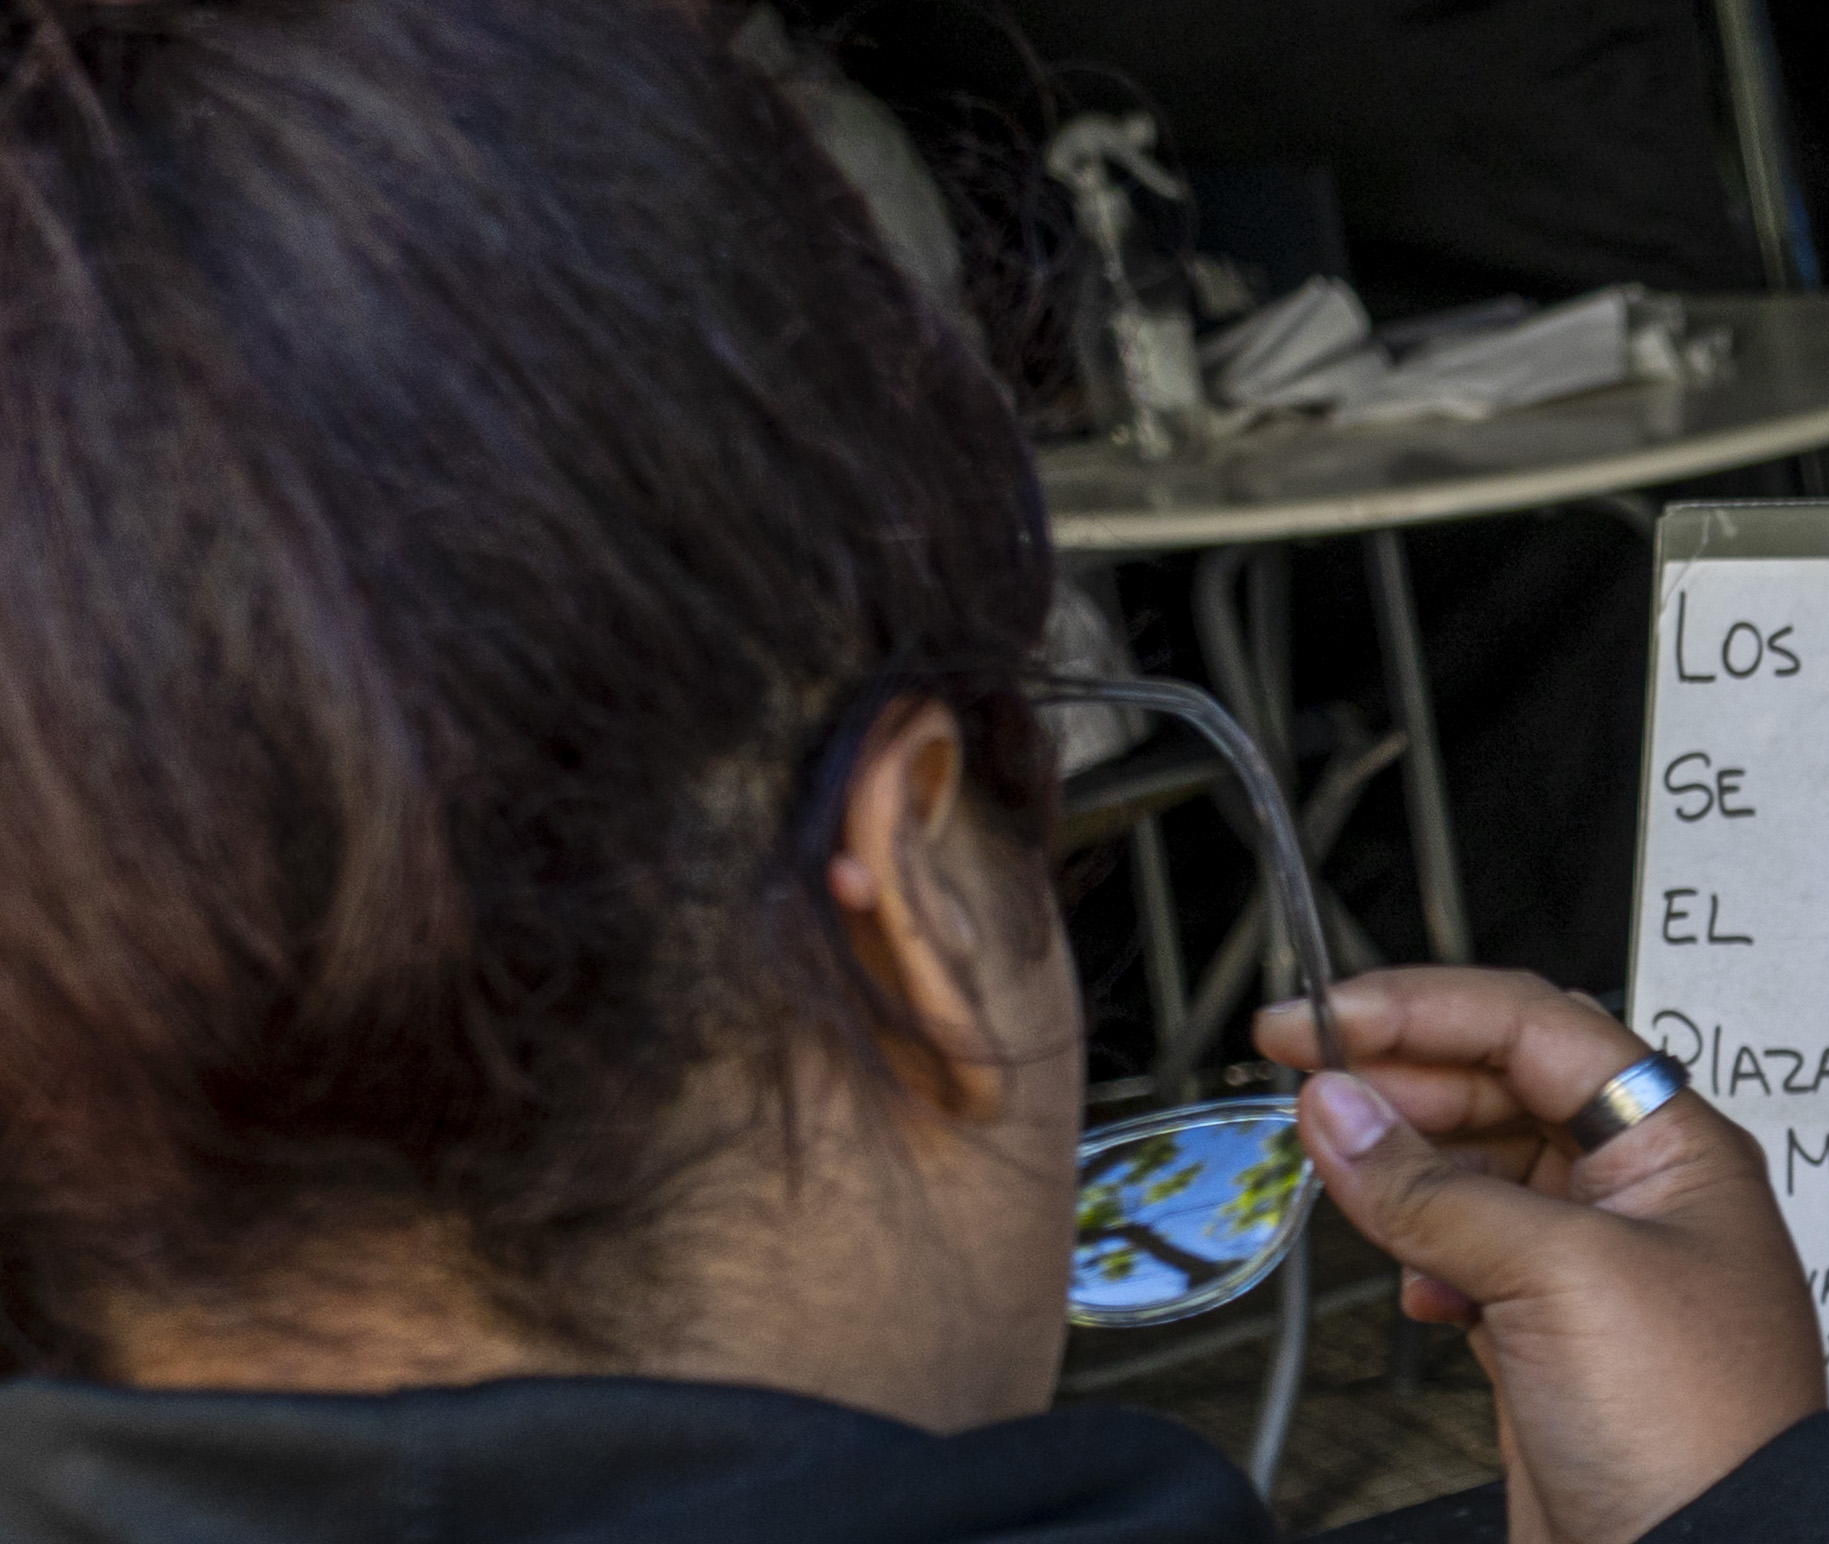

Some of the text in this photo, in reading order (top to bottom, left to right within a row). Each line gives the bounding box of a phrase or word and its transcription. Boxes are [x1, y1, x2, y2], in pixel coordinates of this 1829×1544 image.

[1674, 590, 1802, 684] LOS
[1662, 752, 1757, 823] SE
[1661, 888, 1755, 947] EL
